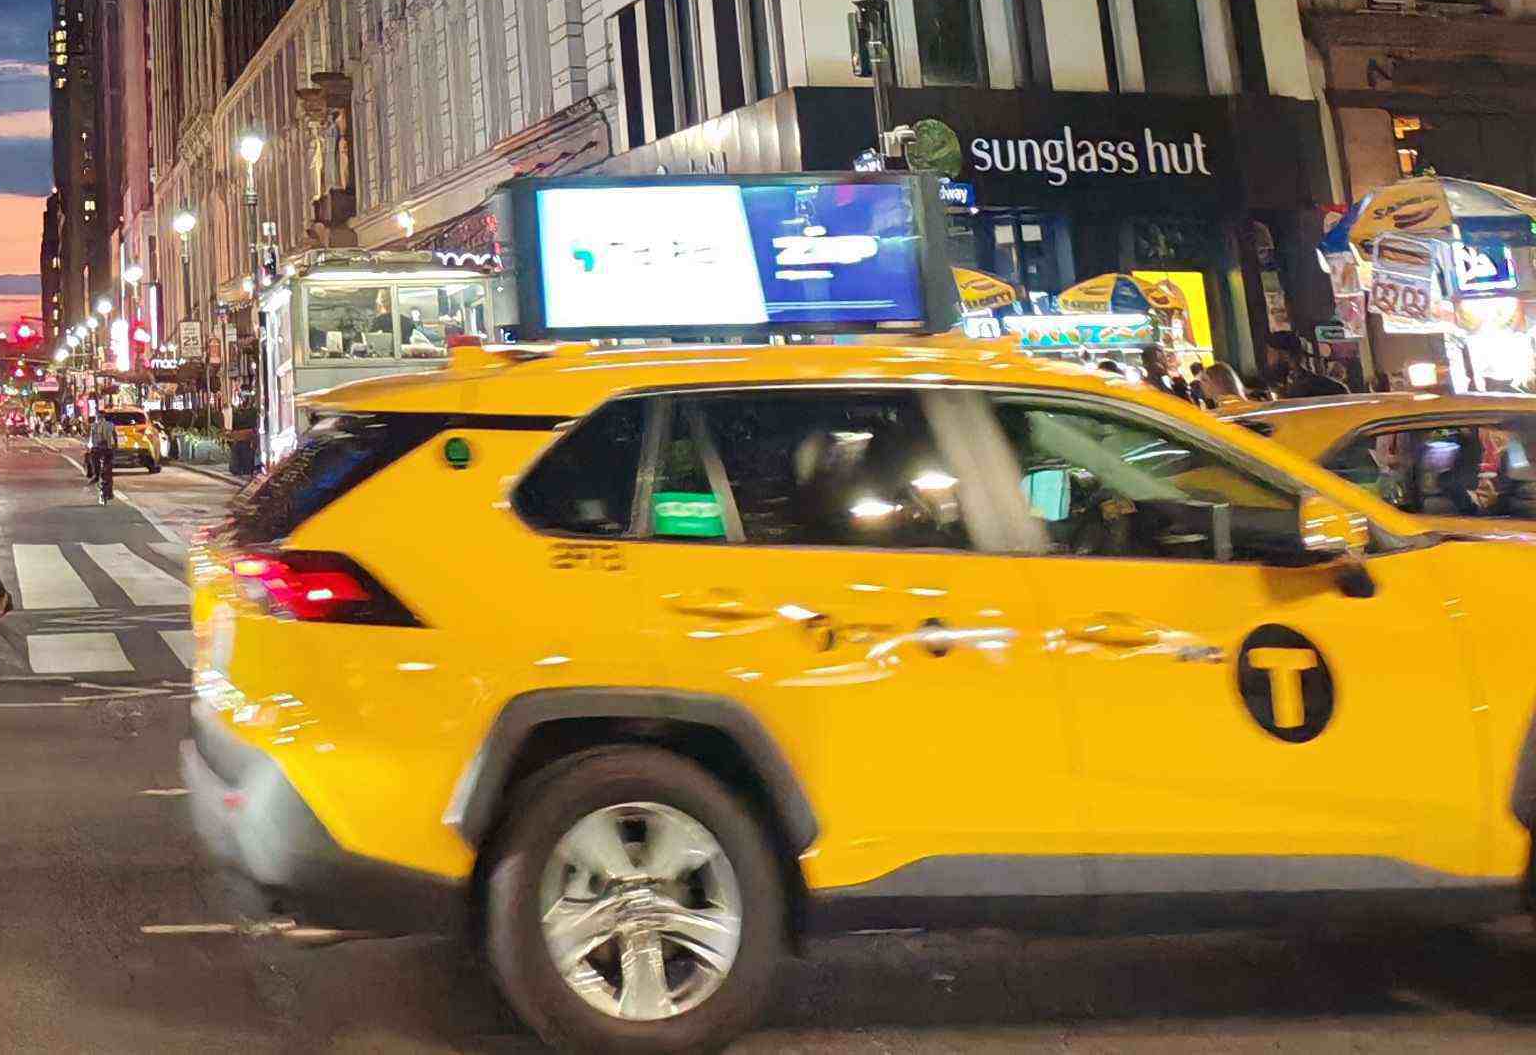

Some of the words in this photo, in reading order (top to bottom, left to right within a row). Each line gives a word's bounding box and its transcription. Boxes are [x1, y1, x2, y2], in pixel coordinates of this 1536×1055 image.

[970, 125, 1139, 187] sunglass
[1144, 127, 1212, 176] hut
[183, 336, 199, 346] 25
[1247, 647, 1318, 728] T
